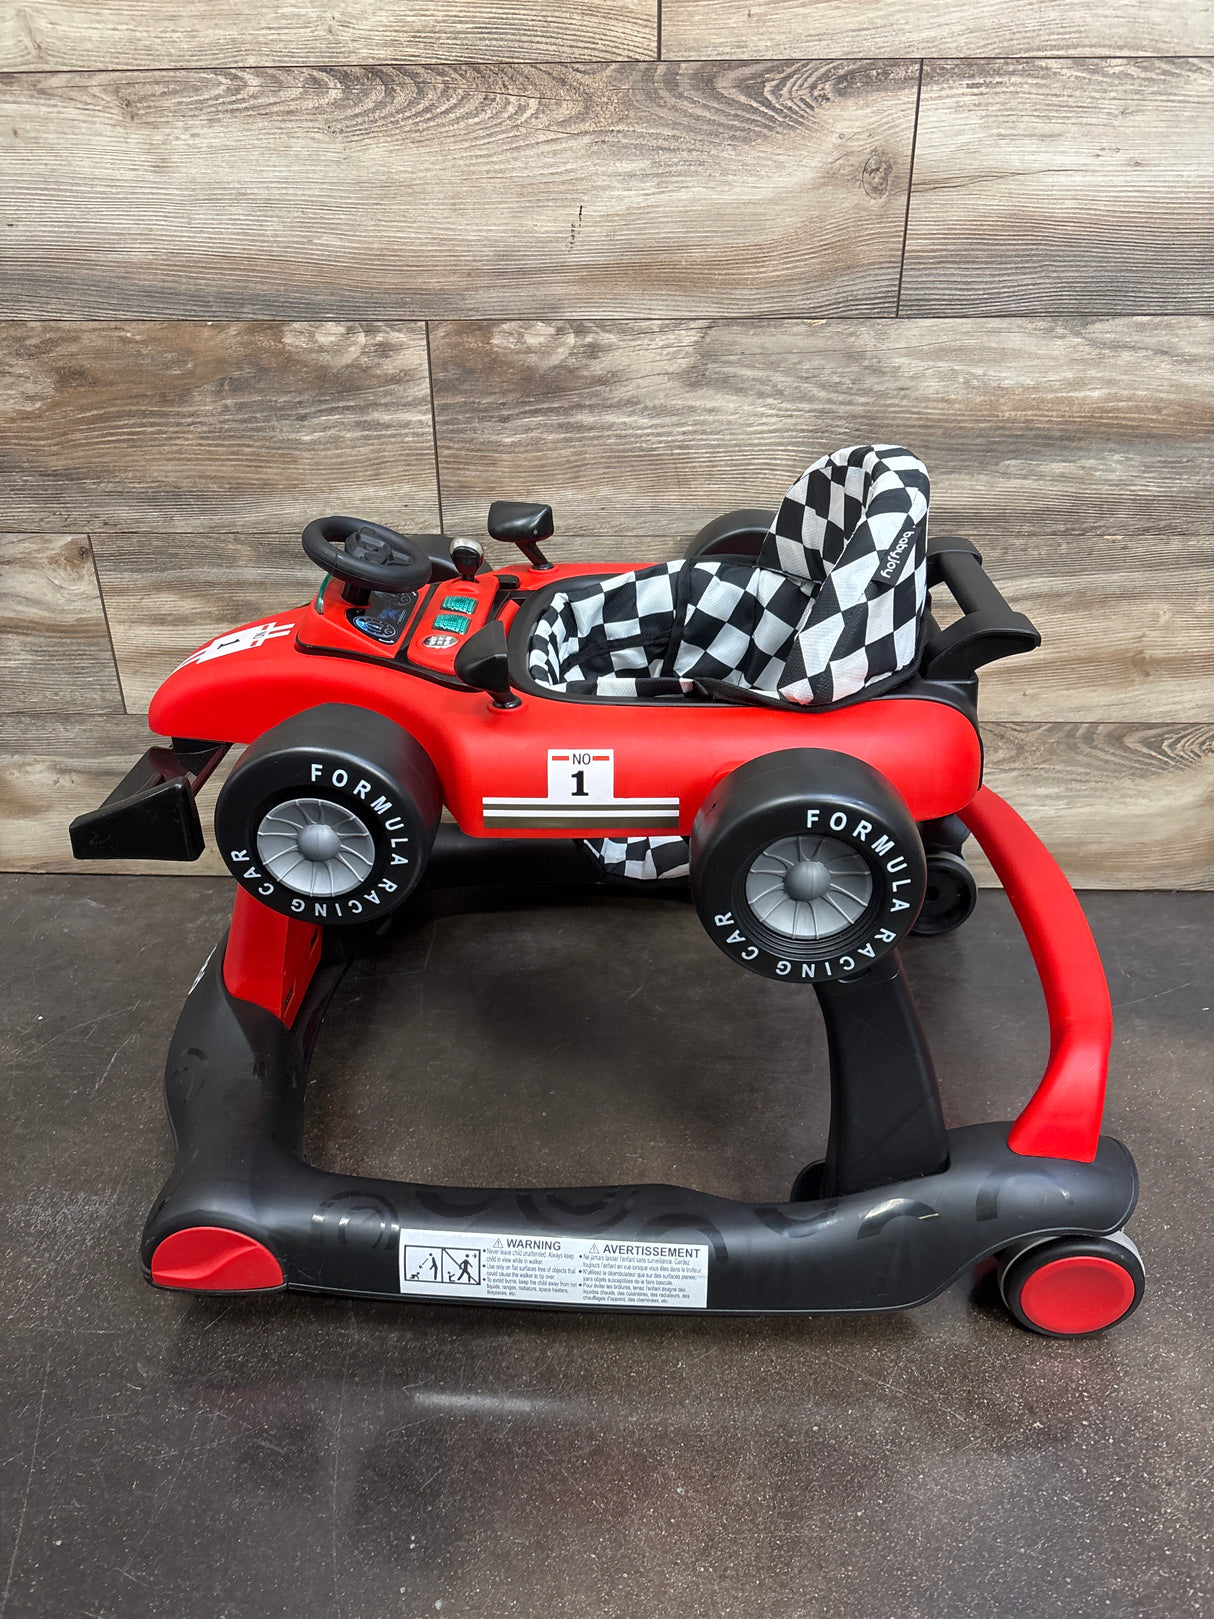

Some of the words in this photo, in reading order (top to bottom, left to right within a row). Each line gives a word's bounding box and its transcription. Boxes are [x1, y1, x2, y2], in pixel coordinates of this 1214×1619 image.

[880, 531, 914, 578] babyjoy
[572, 753, 591, 765] NO
[571, 770, 589, 796] 1
[310, 764, 408, 865] FORMULA
[230, 849, 274, 896] CAR
[806, 810, 912, 912] FORMULA
[290, 878, 398, 917] RACING
[714, 912, 759, 960] CAR
[775, 928, 896, 978] RACING
[507, 1238, 561, 1250] WARNING
[603, 1244, 700, 1258] AVERTISSEMENT
